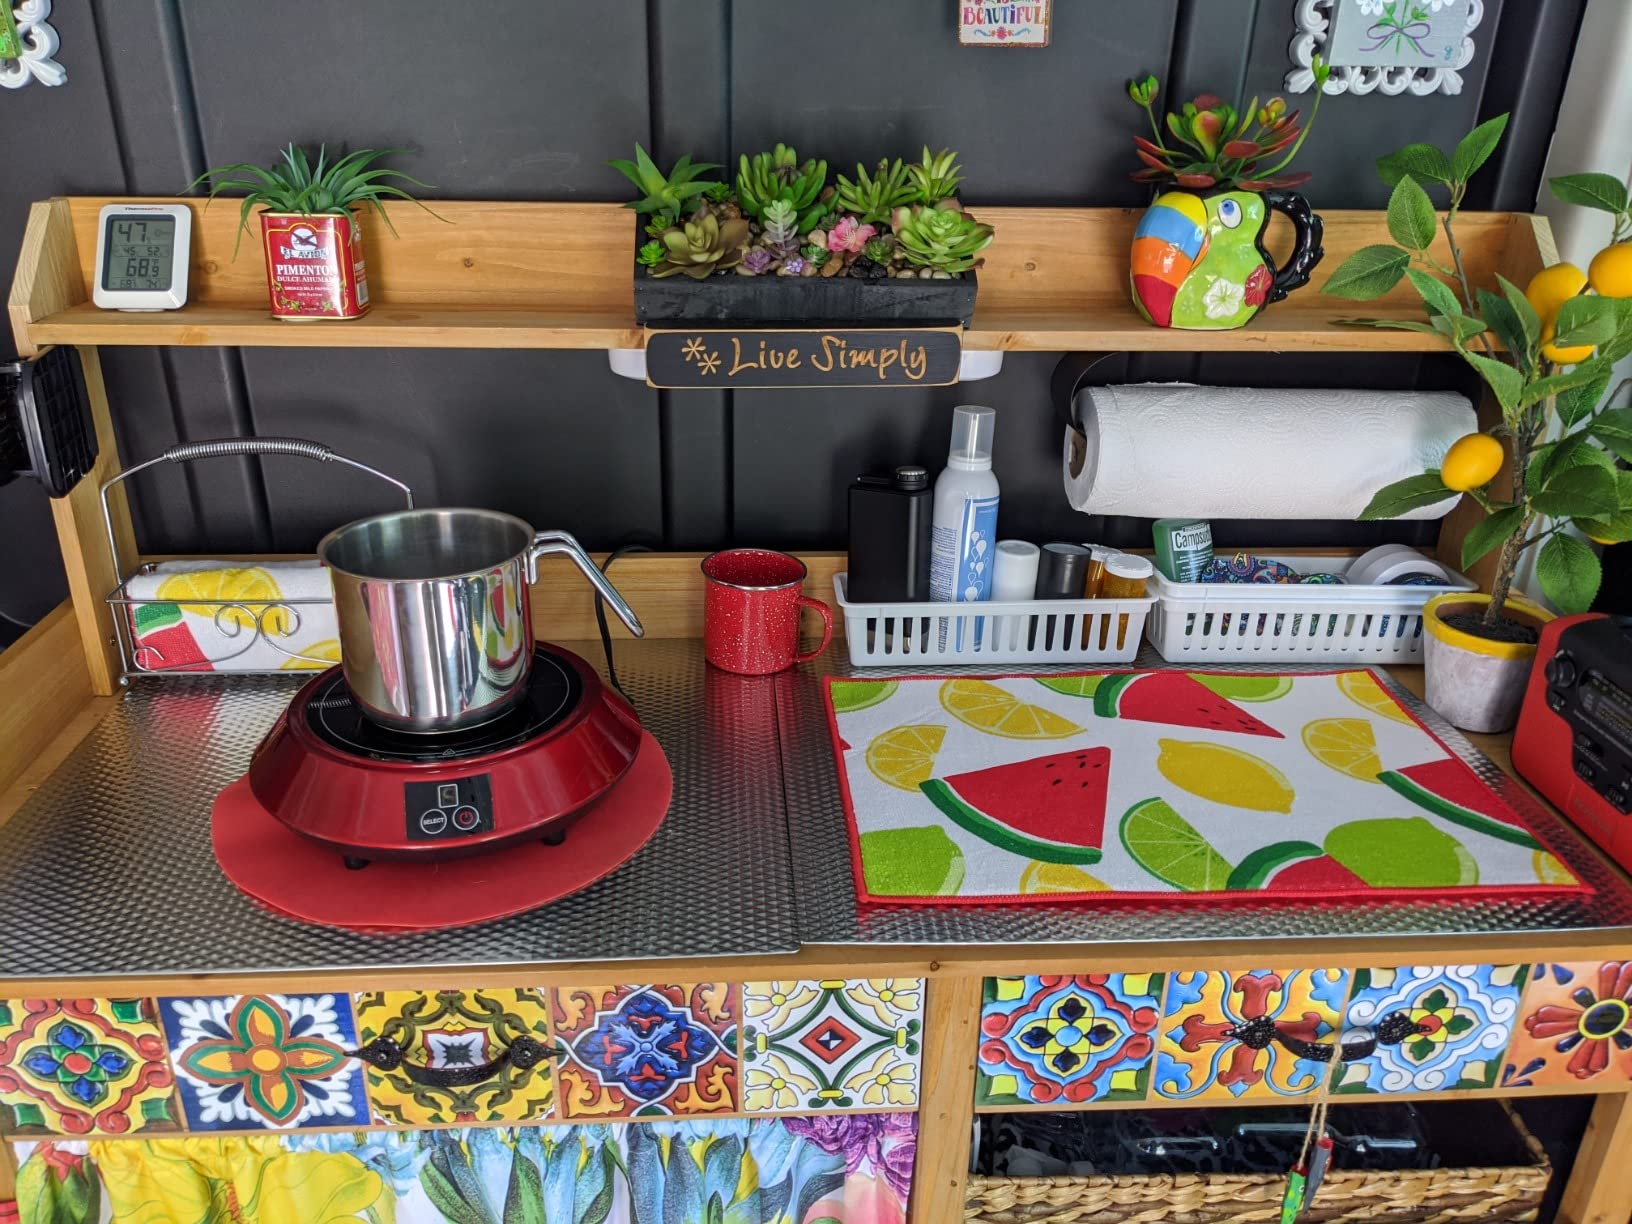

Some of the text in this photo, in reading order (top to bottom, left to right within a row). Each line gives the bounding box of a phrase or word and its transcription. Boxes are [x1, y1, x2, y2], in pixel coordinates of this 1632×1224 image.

[118, 222, 147, 243] 47
[147, 246, 160, 256] 52
[298, 249, 327, 258] AVION
[277, 275, 301, 283] DULCE
[728, 335, 928, 380] Live Simply
[423, 817, 445, 826] SELECT
